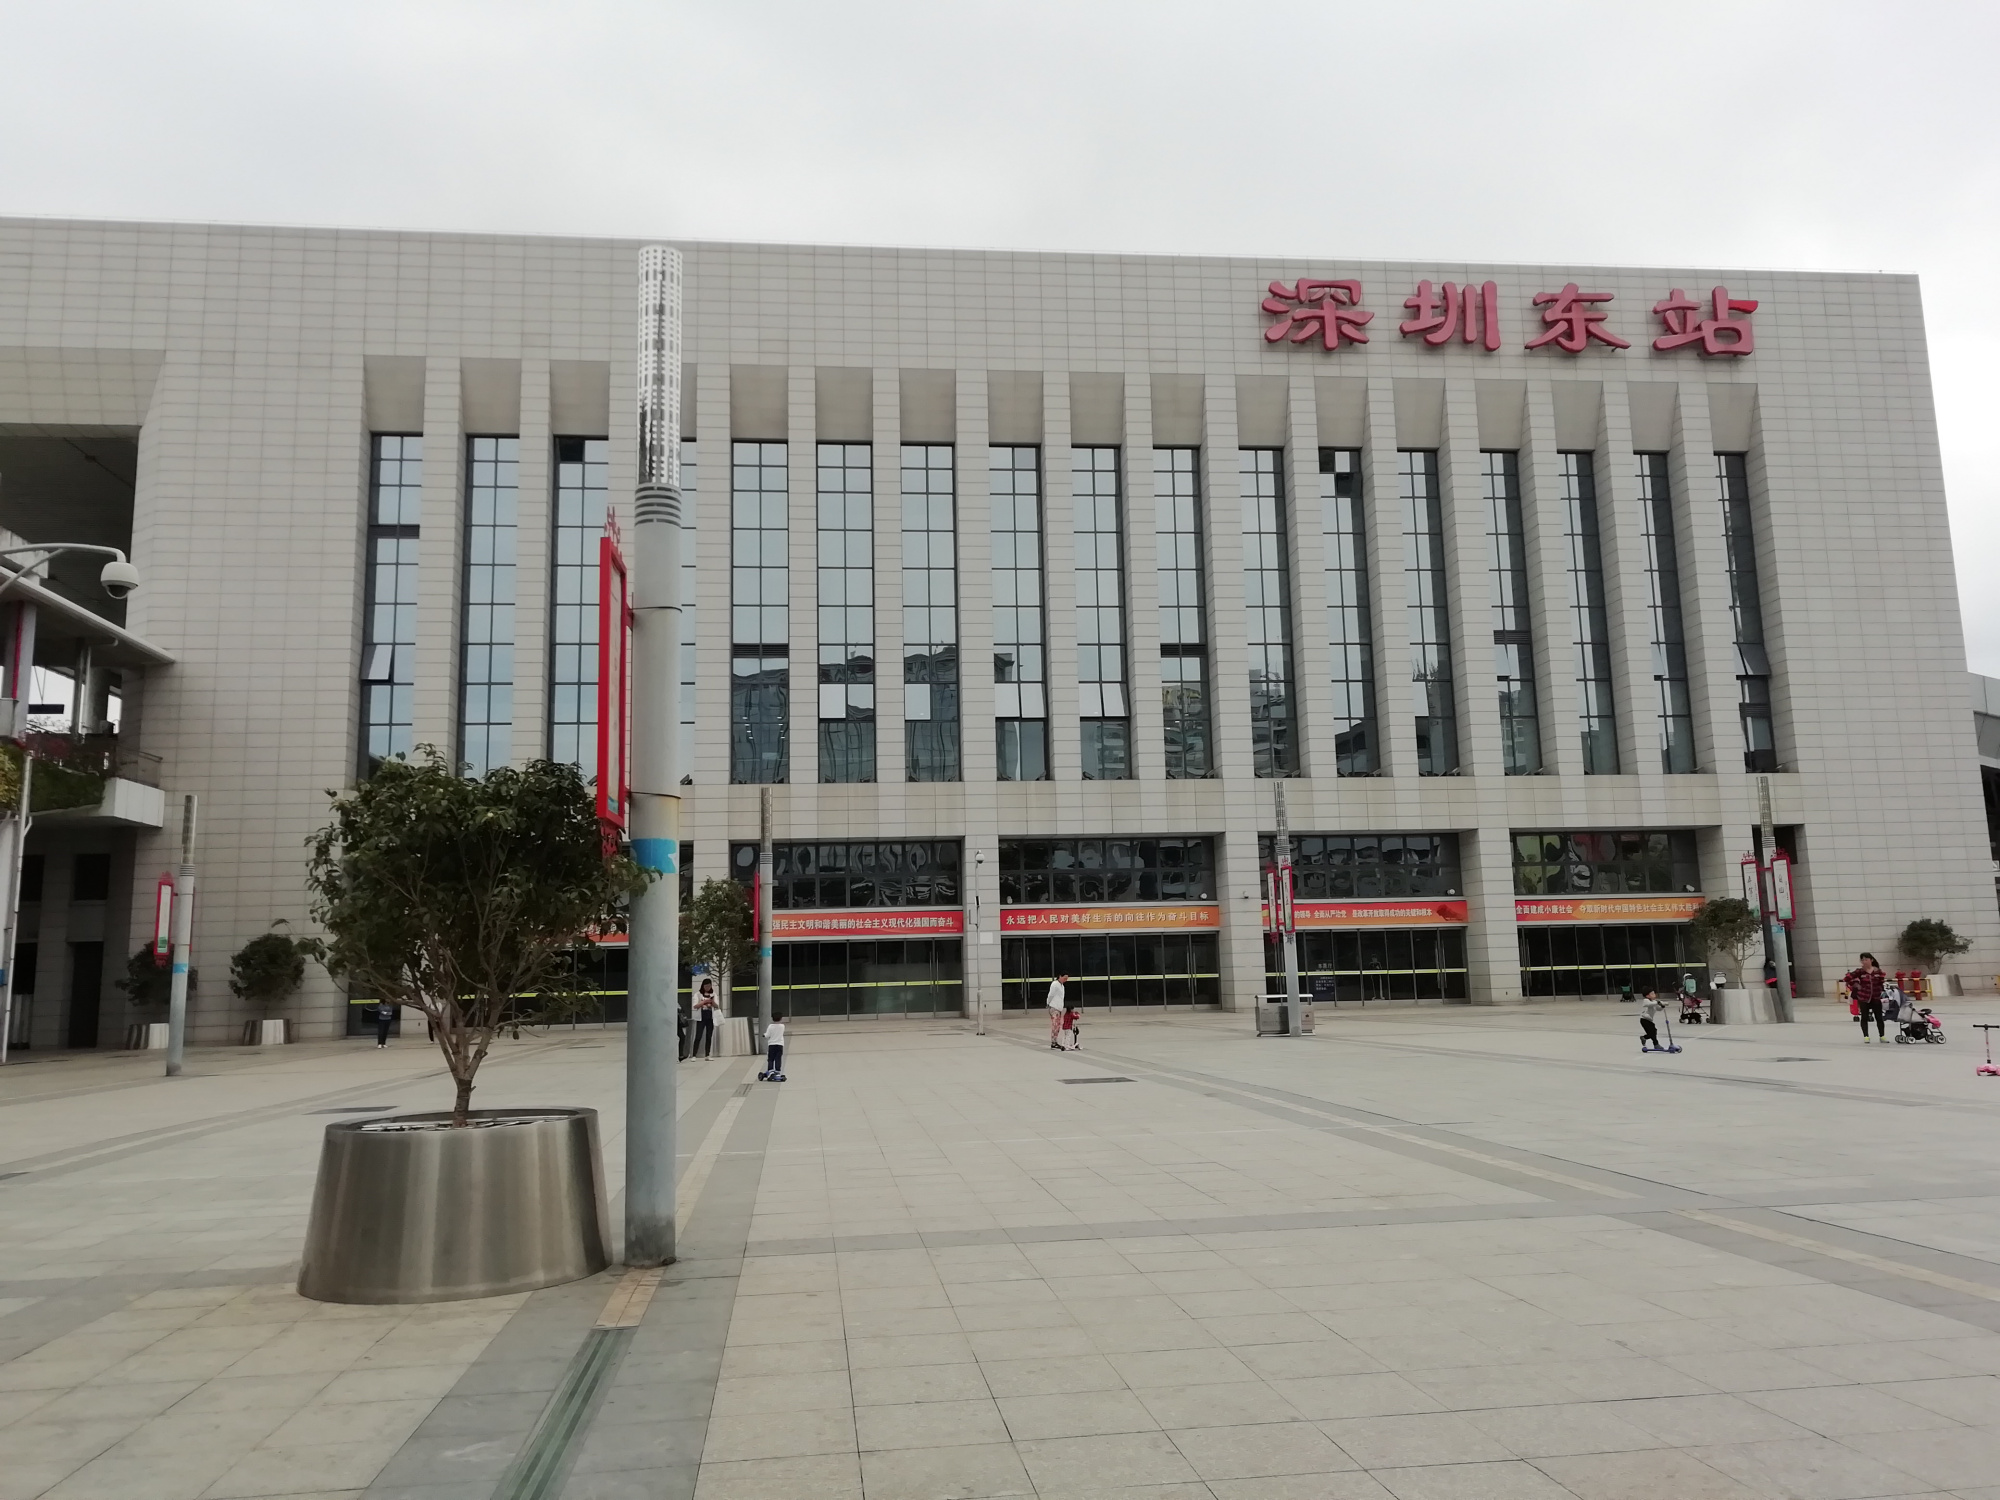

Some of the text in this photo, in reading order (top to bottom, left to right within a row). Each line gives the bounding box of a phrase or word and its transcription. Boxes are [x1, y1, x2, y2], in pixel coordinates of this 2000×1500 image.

[1262, 279, 1759, 358] 深圳东站
[1516, 904, 1573, 915] 全面建成小康社会
[1006, 911, 1210, 925] 永远把人民对美好生活的向往作为奋斗目标
